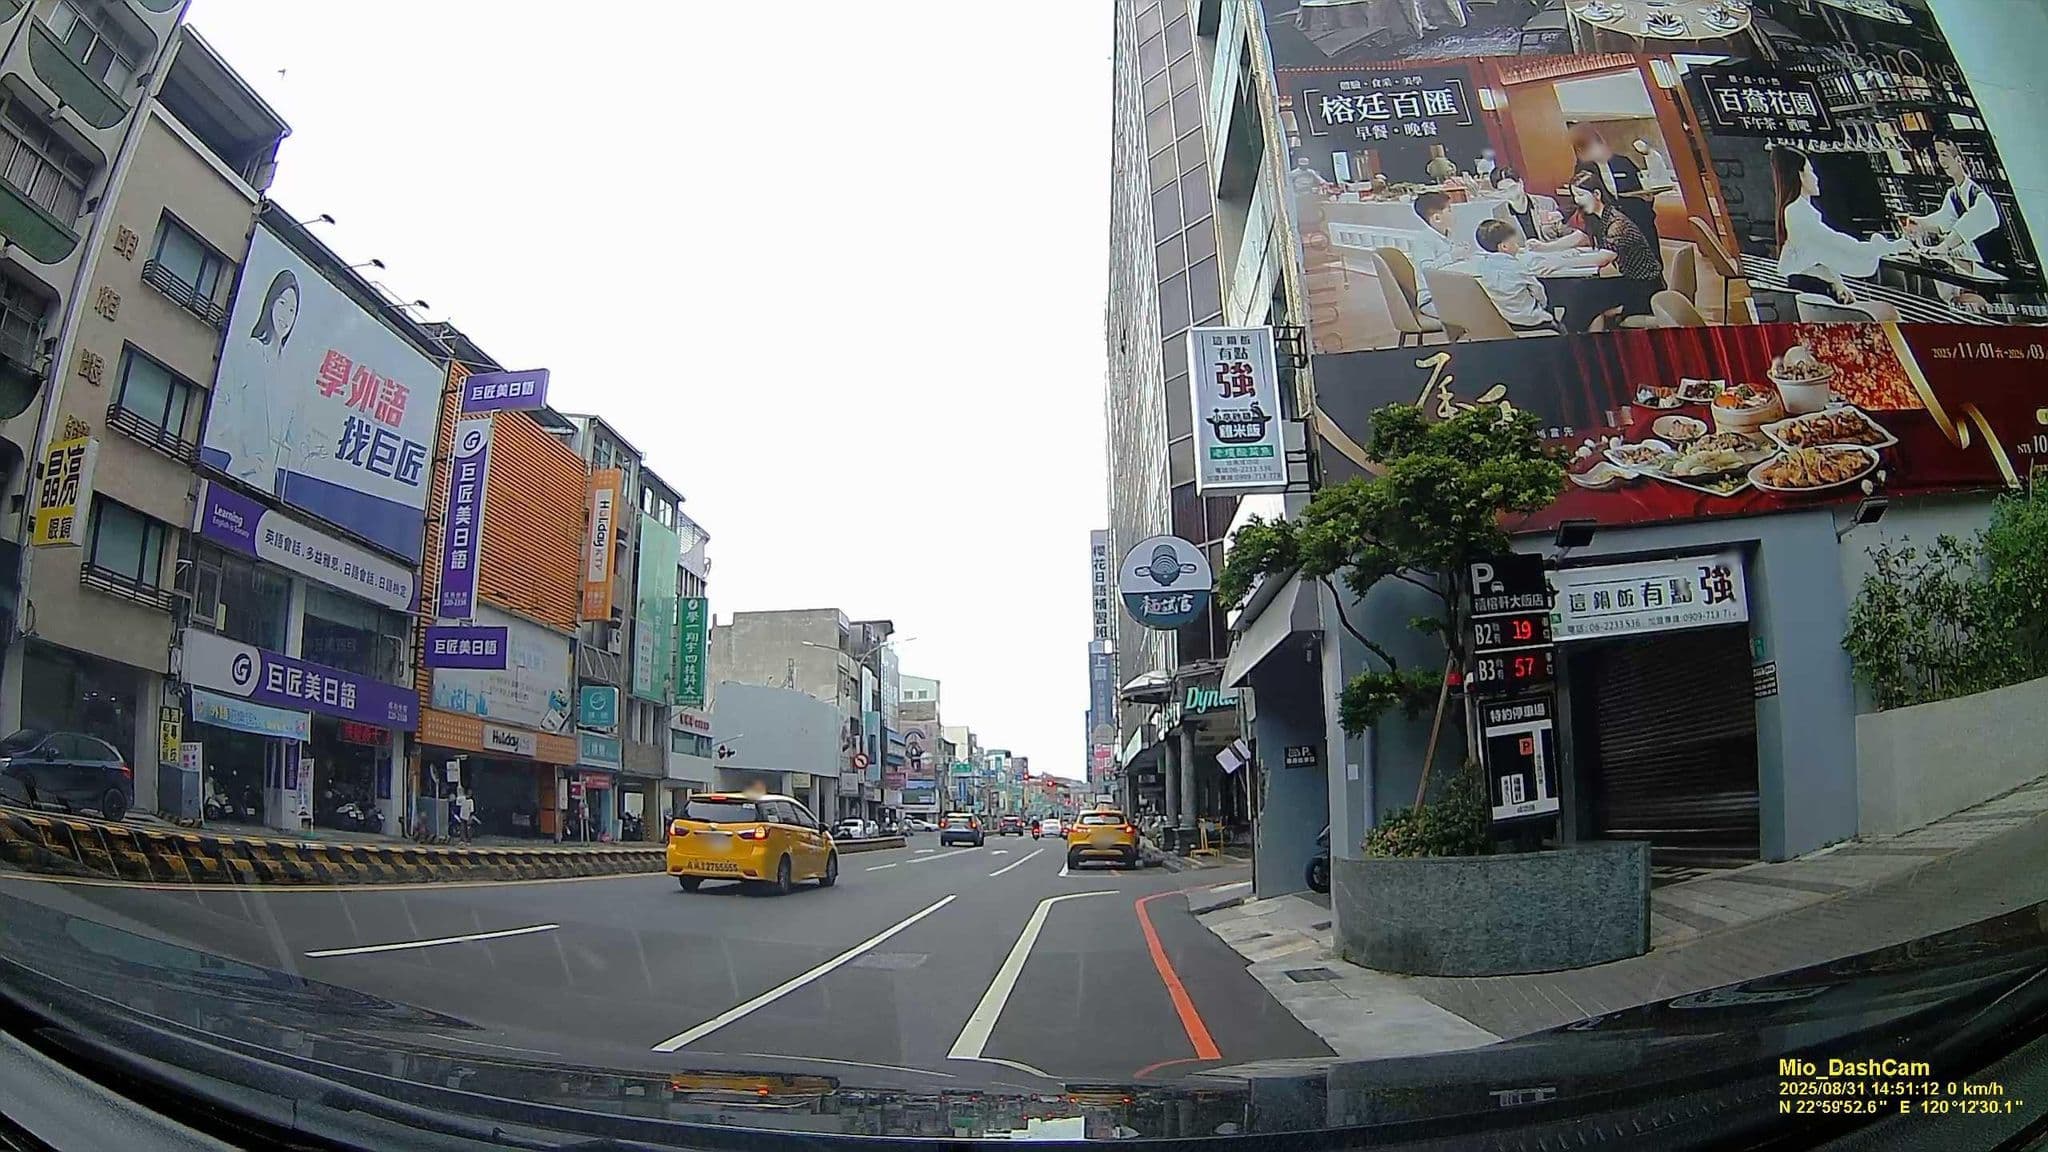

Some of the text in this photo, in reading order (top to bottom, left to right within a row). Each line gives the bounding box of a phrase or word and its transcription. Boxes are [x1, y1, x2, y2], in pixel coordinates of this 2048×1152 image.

[1319, 88, 1459, 125] 榕廷百匯
[316, 349, 411, 428] 學外語
[470, 380, 535, 401] 巨匠美日語
[1214, 361, 1256, 399] 強
[335, 415, 428, 487] 找巨匠
[214, 503, 244, 527] Learning
[451, 462, 477, 570] 巨匠美日語
[1471, 563, 1494, 594] P
[434, 639, 498, 655] 巨匠美日語
[1475, 623, 1493, 645] B2
[1512, 620, 1532, 640] 19
[266, 662, 357, 710] 巨匠美日語
[1478, 659, 1496, 681] B3
[1514, 657, 1534, 677] 57
